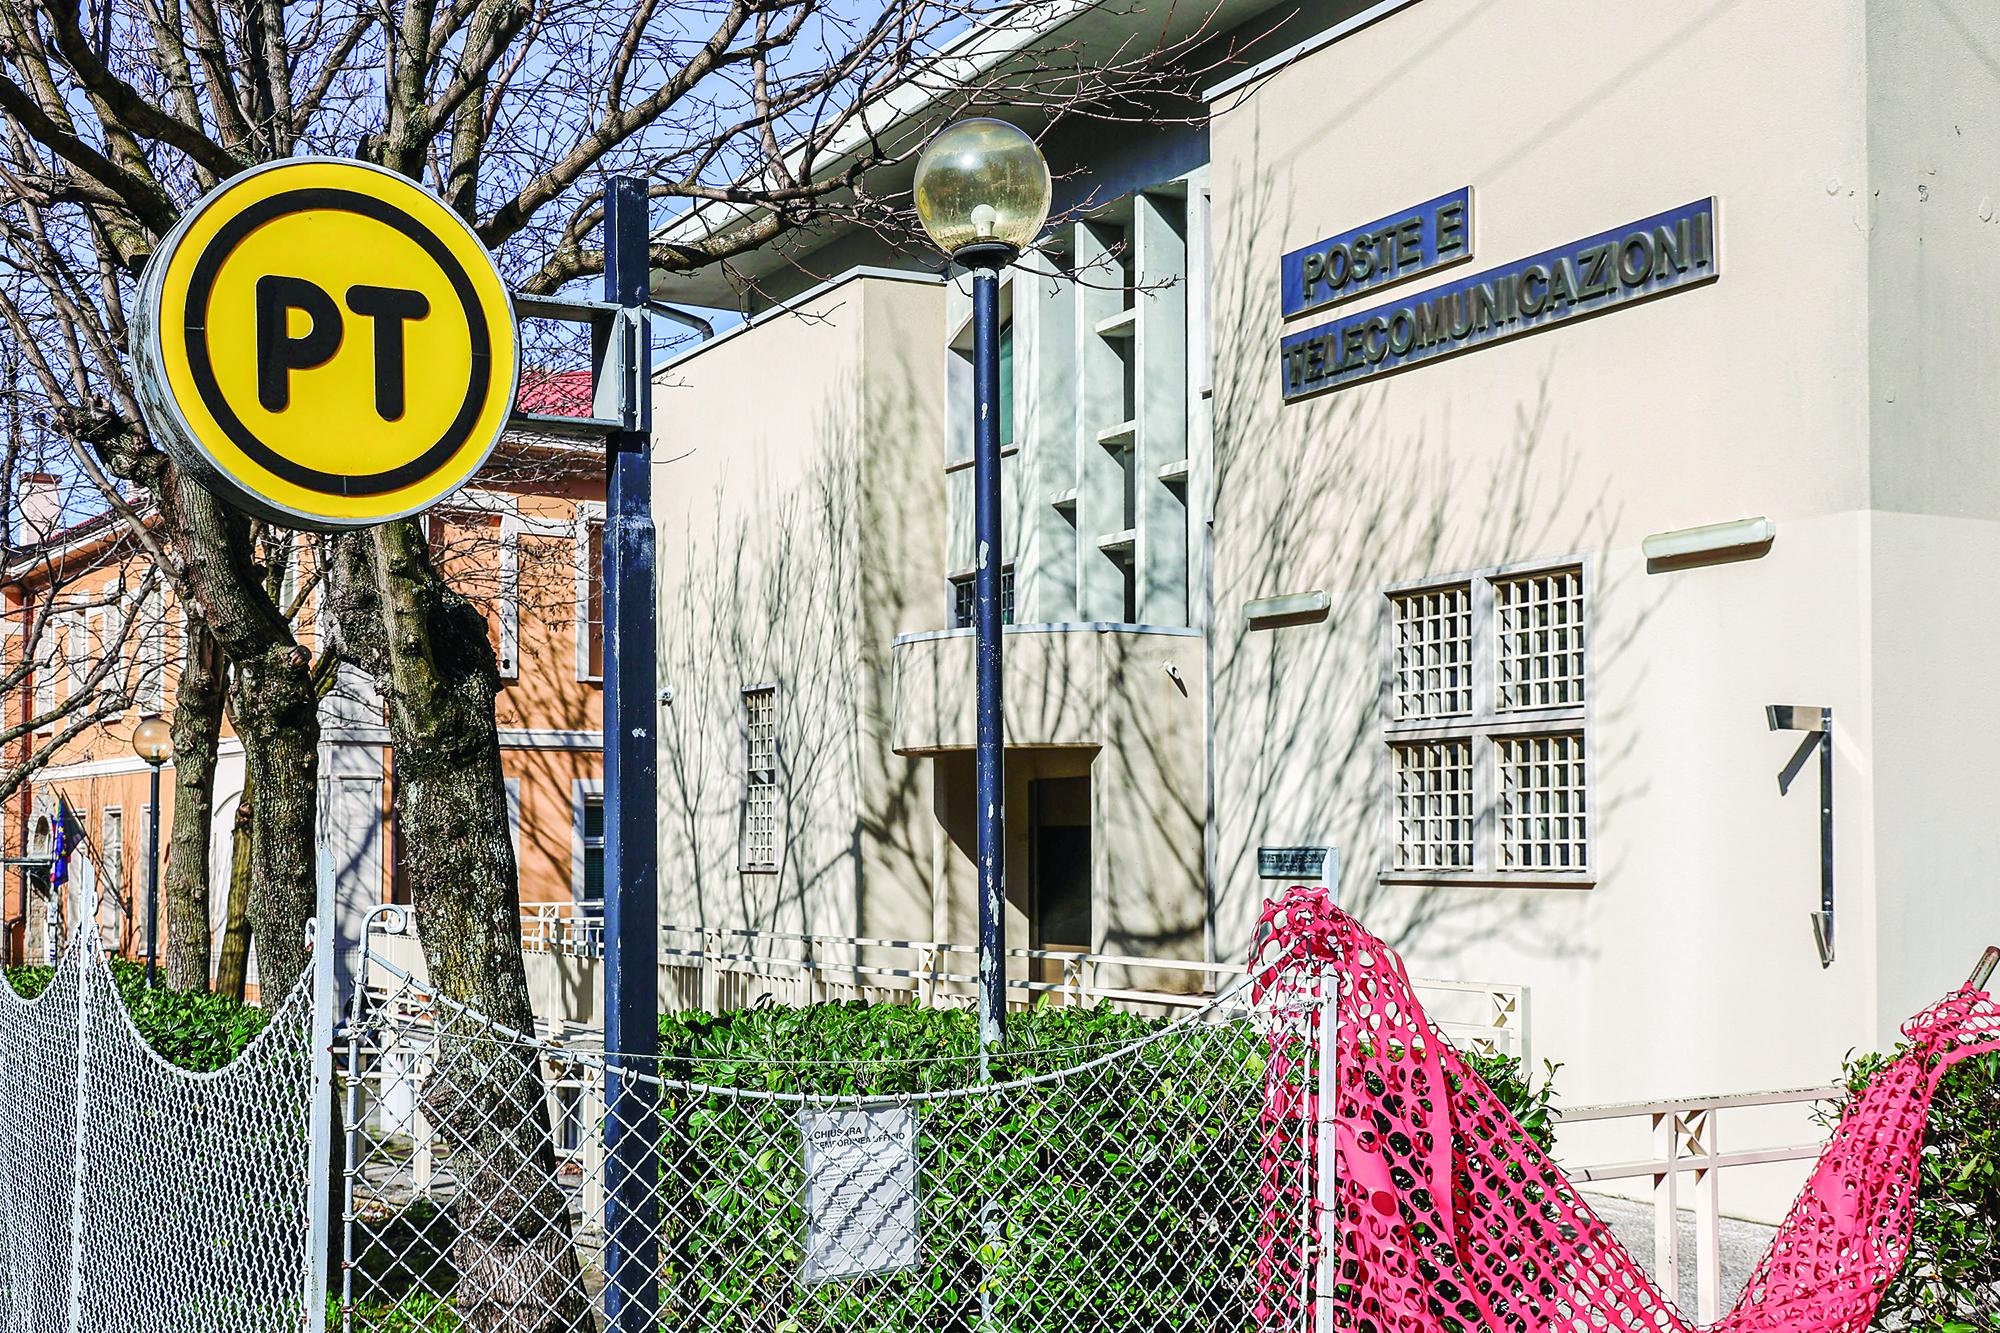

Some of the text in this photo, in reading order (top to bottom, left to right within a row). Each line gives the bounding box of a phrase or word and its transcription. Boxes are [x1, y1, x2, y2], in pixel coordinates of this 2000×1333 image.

[1283, 211, 1711, 388] TELECOMUNICAZIONI
[1303, 200, 1465, 299] POSTE E
[256, 274, 430, 422] PT
[814, 1126, 862, 1139] CHIUSRA
